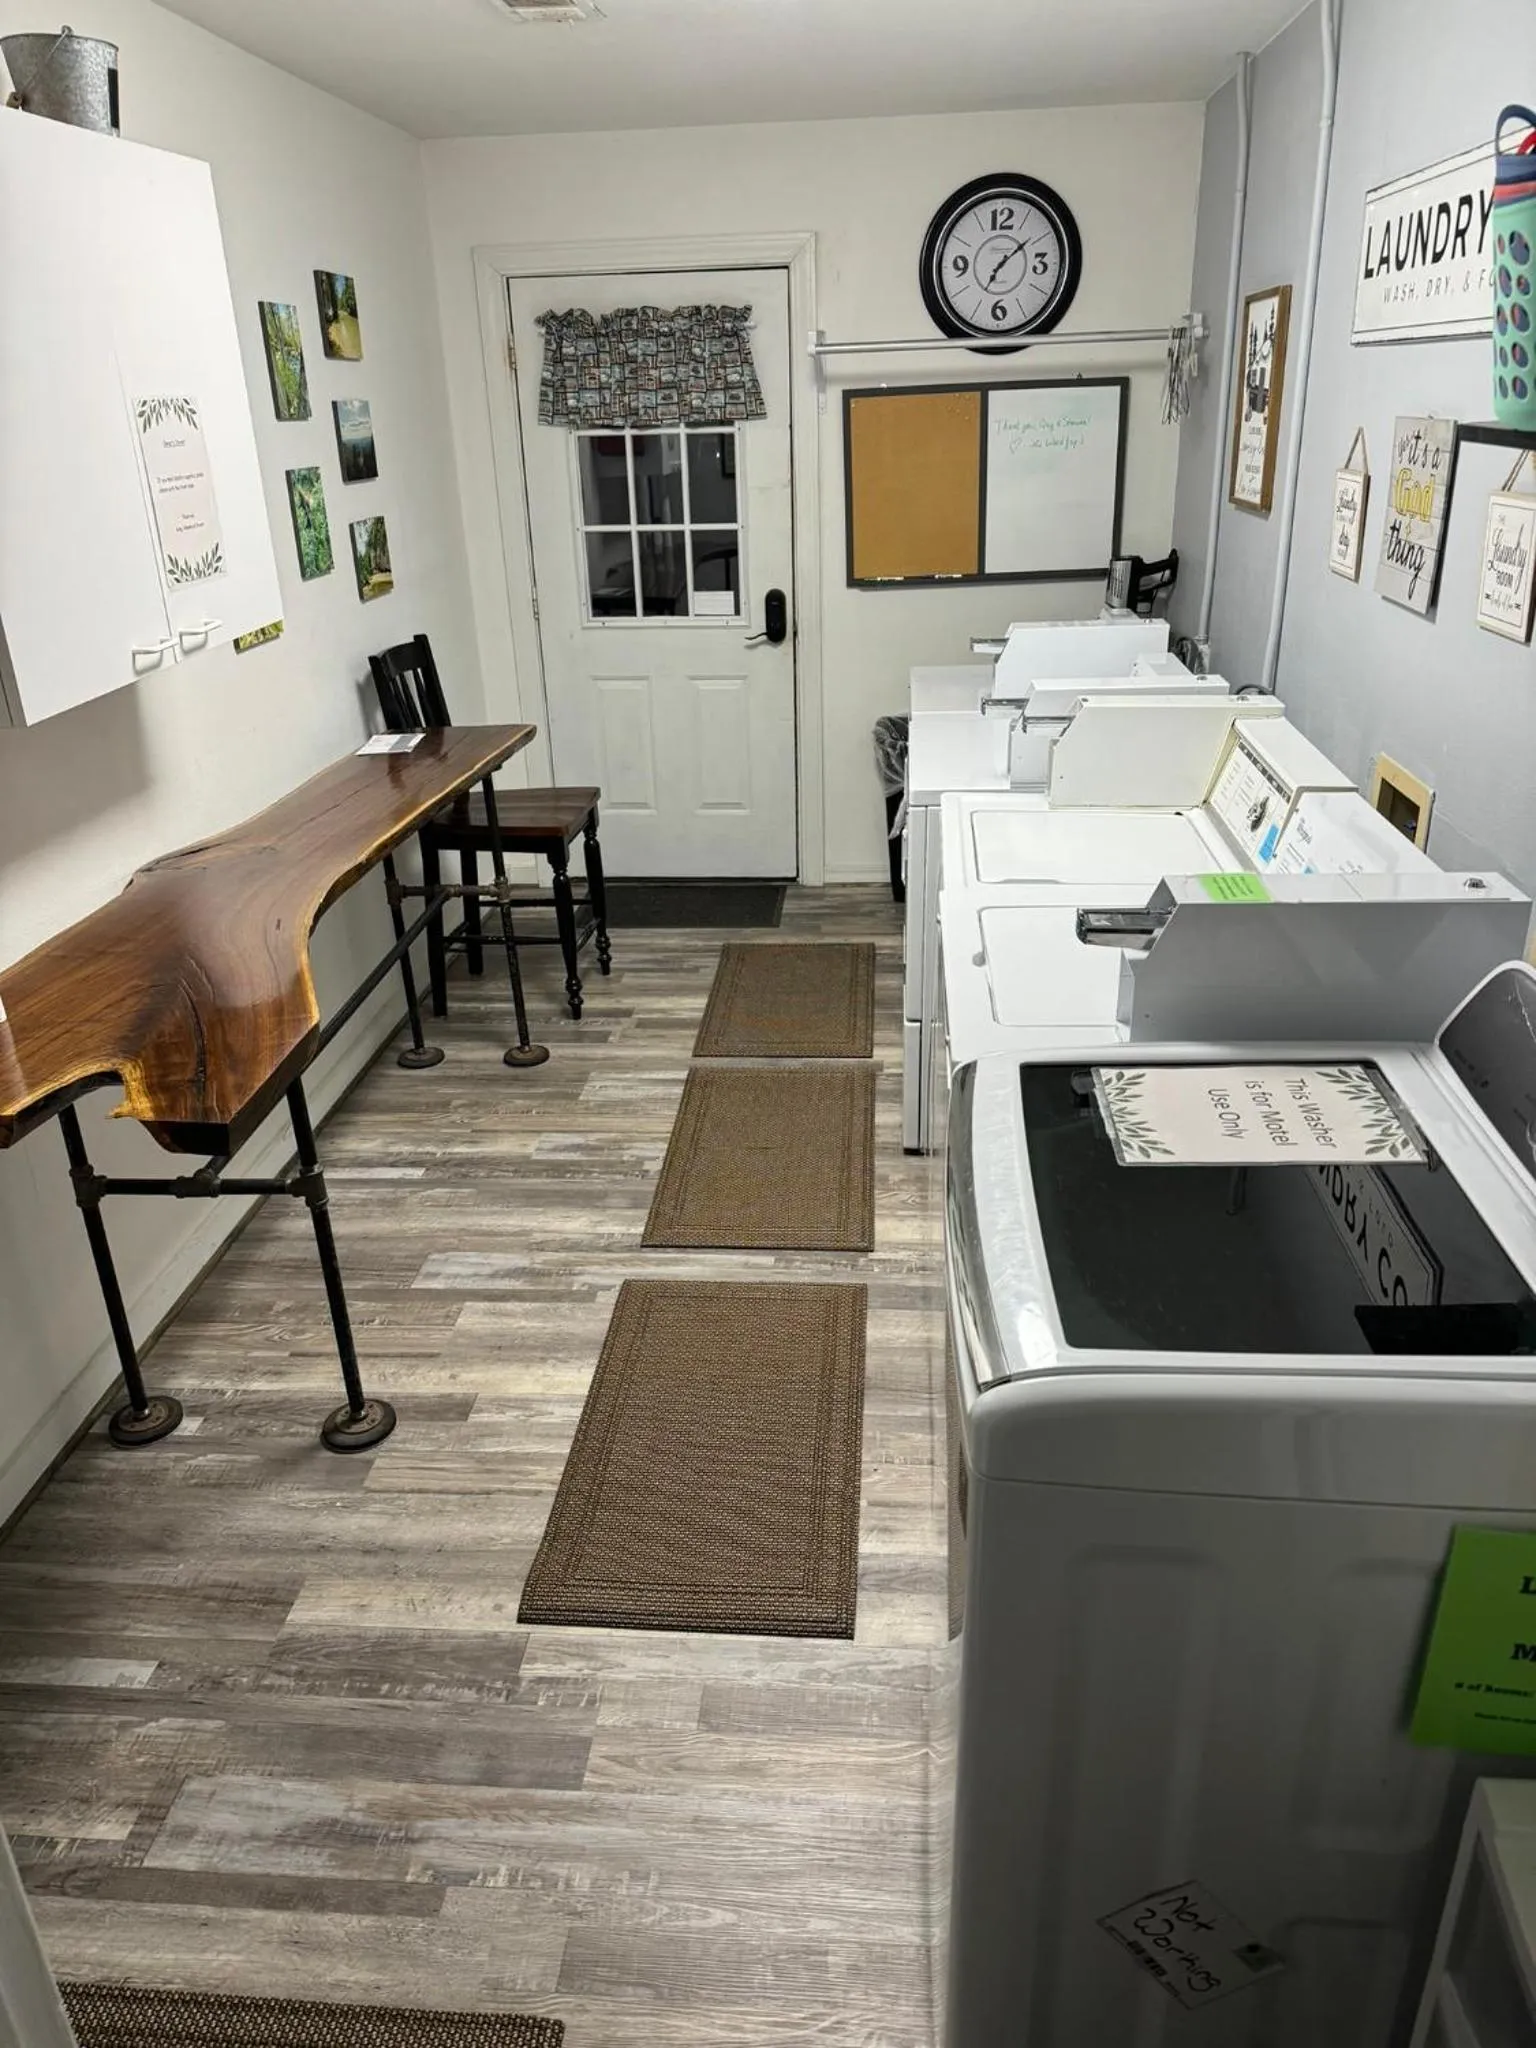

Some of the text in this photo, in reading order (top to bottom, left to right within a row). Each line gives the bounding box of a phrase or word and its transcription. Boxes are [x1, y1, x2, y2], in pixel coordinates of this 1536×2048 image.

[990, 207, 1014, 231] 12
[1364, 189, 1494, 280] LAUNDRY
[952, 255, 969, 278] 9
[1032, 252, 1048, 275] 3
[1383, 282, 1419, 303] WASH,
[1426, 276, 1455, 298] DRY,
[991, 299, 1007, 321] 6
[1386, 518, 1426, 601] thing
[1208, 1088, 1249, 1139] Use Only
[1244, 1080, 1298, 1146] is for Motel
[1284, 1078, 1337, 1149] This Washer
